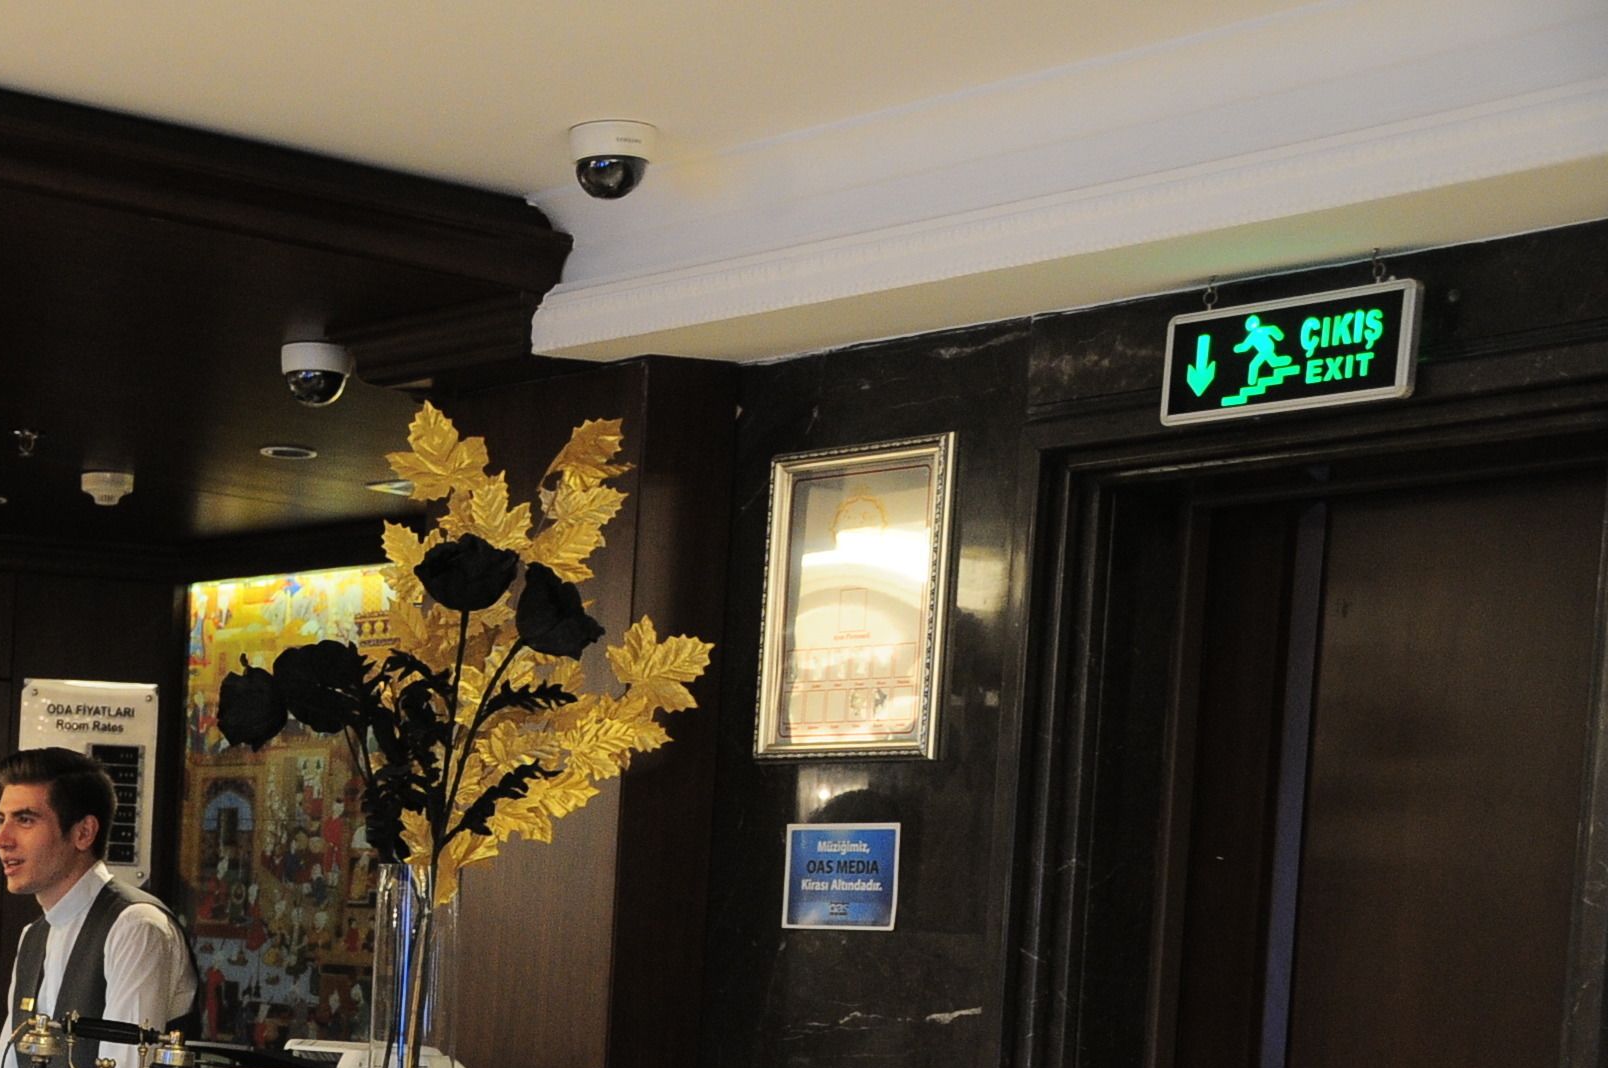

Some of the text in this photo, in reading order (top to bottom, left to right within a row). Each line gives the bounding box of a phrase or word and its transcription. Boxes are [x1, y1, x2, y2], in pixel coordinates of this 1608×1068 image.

[1299, 308, 1383, 358] ÇIKIŞ
[1305, 352, 1375, 385] EXIT
[47, 703, 135, 718] ODA FİYATLARI
[56, 719, 124, 733] Room Rates
[806, 860, 880, 874] OAS MEDIA
[801, 878, 828, 891] Kirası
